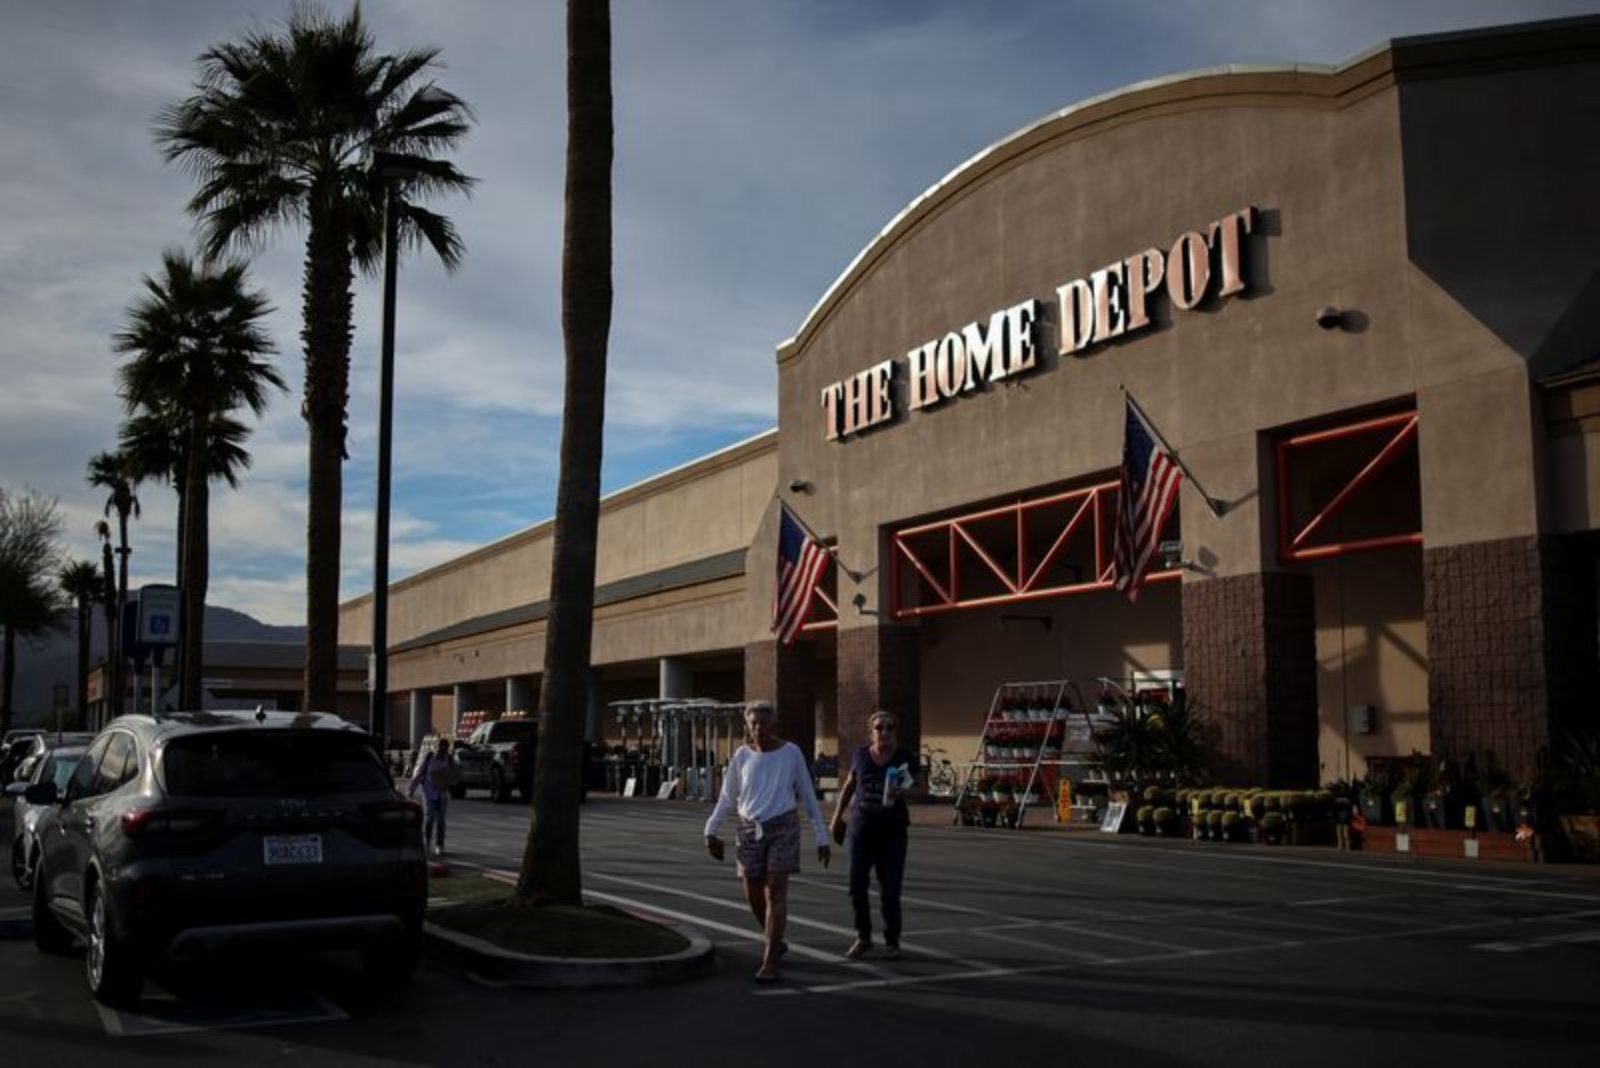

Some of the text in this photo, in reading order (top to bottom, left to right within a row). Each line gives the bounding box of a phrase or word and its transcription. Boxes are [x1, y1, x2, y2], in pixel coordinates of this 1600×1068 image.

[821, 206, 1258, 441] THE HOME DEPOT
